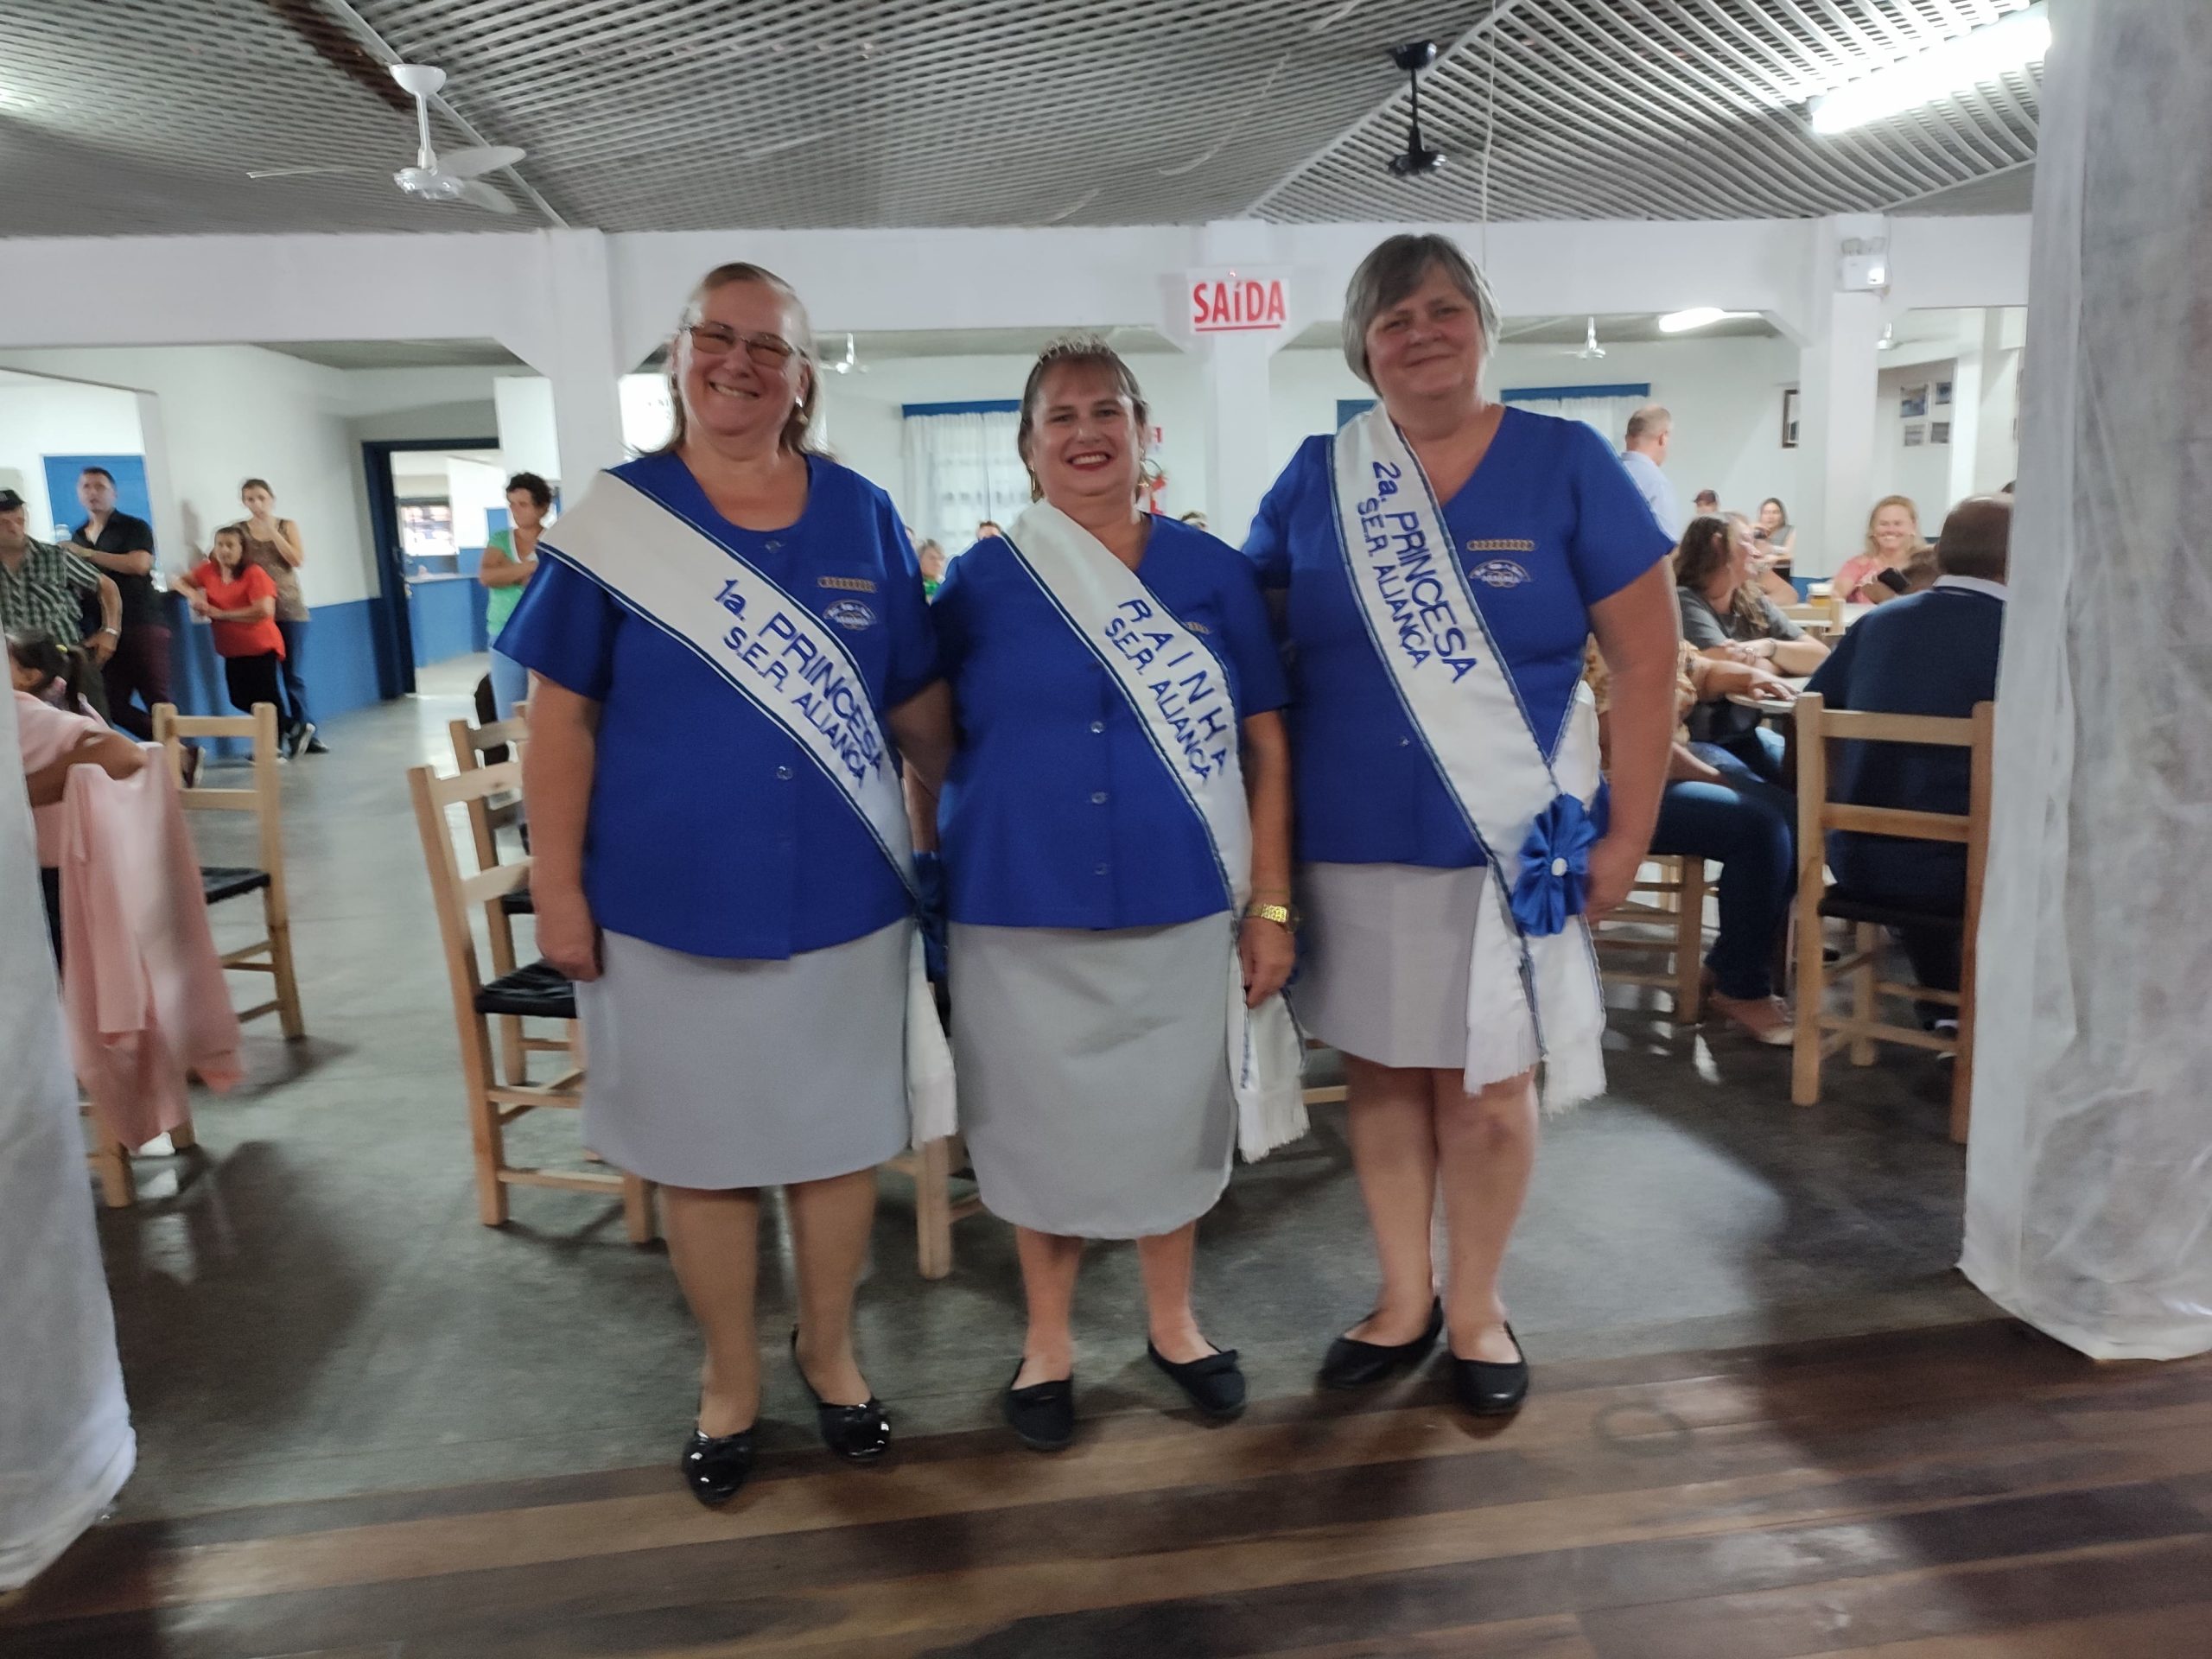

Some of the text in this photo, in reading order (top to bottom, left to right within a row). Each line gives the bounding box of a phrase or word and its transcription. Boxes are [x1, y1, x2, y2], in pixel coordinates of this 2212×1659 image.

[1384, 512, 1477, 683] PRINCESA
[758, 611, 883, 782] PRINCESA
[1117, 599, 1227, 776] RAINHA
